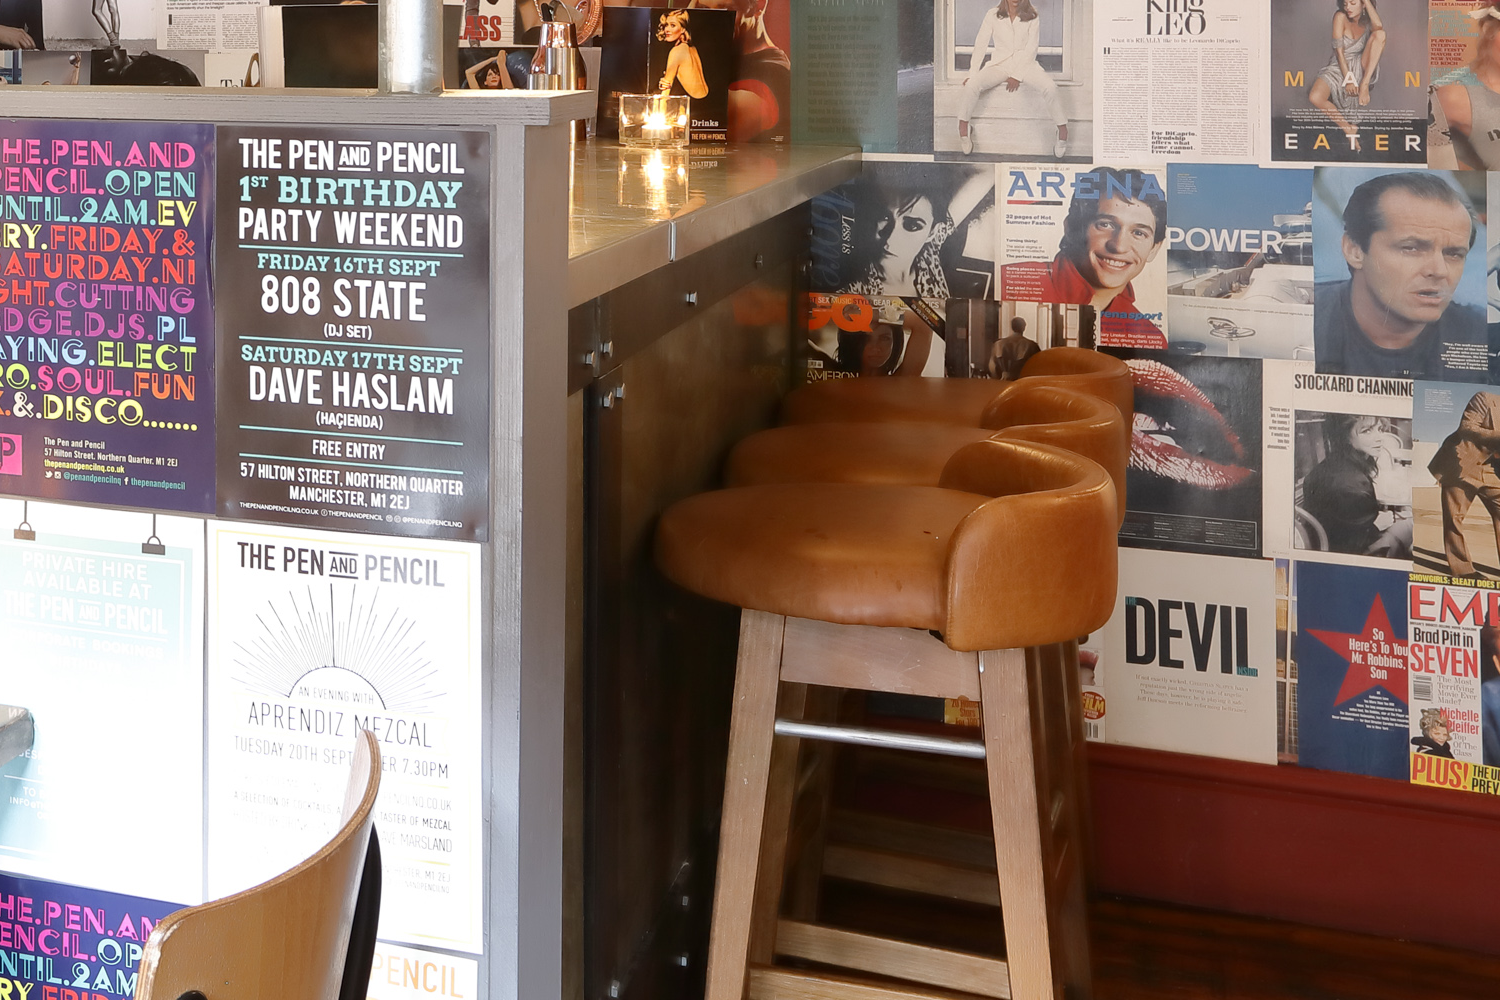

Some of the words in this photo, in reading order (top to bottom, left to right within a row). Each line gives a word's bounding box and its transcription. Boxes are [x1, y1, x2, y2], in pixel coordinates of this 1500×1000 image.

[1147, 13, 1206, 35] LEO
[1285, 133, 1422, 153] EATER
[1008, 170, 1166, 201] ARENA
[238, 207, 322, 243] PARTY
[334, 211, 463, 248] WEEKEND
[1166, 227, 1283, 254] POWER
[257, 253, 329, 271] FRIDAY
[334, 256, 383, 274] 16TH
[389, 259, 440, 276] SEPT
[261, 274, 321, 315] 808
[333, 277, 426, 321] STATE
[323, 322, 343, 338] (DJ
[346, 324, 372, 340] SET)
[241, 344, 347, 367] SATURDAY
[351, 351, 404, 370] 17TH
[410, 355, 462, 375] SEPT
[249, 365, 323, 405] DAVE
[333, 370, 453, 415] HASLAM
[1295, 373, 1354, 394] STOCKARD
[313, 439, 343, 457] FREE
[346, 441, 385, 460] ENTRY
[240, 462, 255, 478] 57
[258, 464, 294, 482] HILTON
[298, 466, 343, 487] STREET,
[346, 470, 406, 490] NORTHERN
[410, 475, 463, 496] QUARTER
[289, 485, 367, 508] MANCHESTER,
[370, 489, 387, 507] M1
[390, 492, 409, 510] 2EJ
[1125, 596, 1256, 676] DEVIL
[1410, 643, 1478, 679] SEVEN
